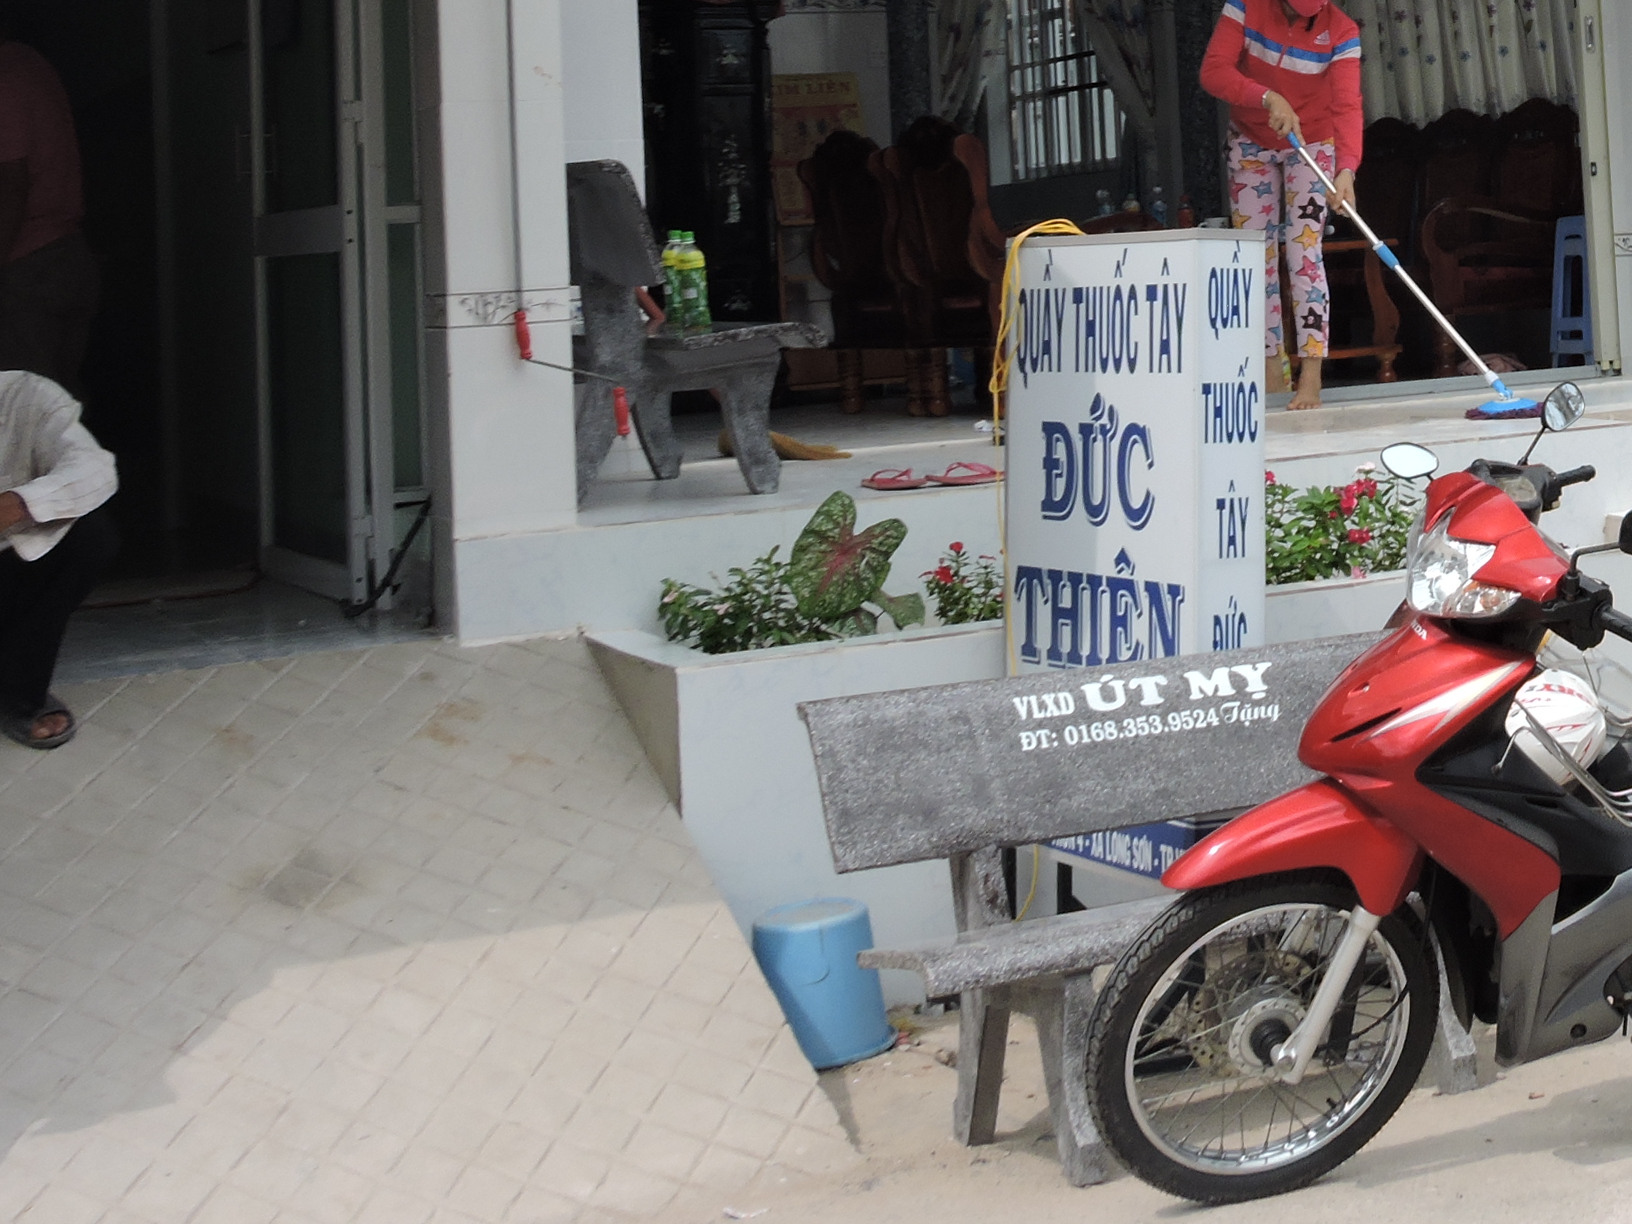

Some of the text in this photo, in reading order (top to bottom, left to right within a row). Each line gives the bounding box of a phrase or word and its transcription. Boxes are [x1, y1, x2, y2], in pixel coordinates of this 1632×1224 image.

[1072, 248, 1138, 374] THUỐC
[1146, 257, 1187, 373] TÂY
[1208, 240, 1252, 340] QUẦY
[1202, 357, 1258, 444] THUỐC
[1041, 392, 1154, 531] ĐỨC
[1216, 480, 1249, 559] TÂY
[1013, 692, 1075, 720] VLXD
[1081, 674, 1168, 711] ÚT
[1019, 701, 1281, 751] ĐT: 0168.353.9524 Tặng
[1105, 830, 1131, 866] LONG
